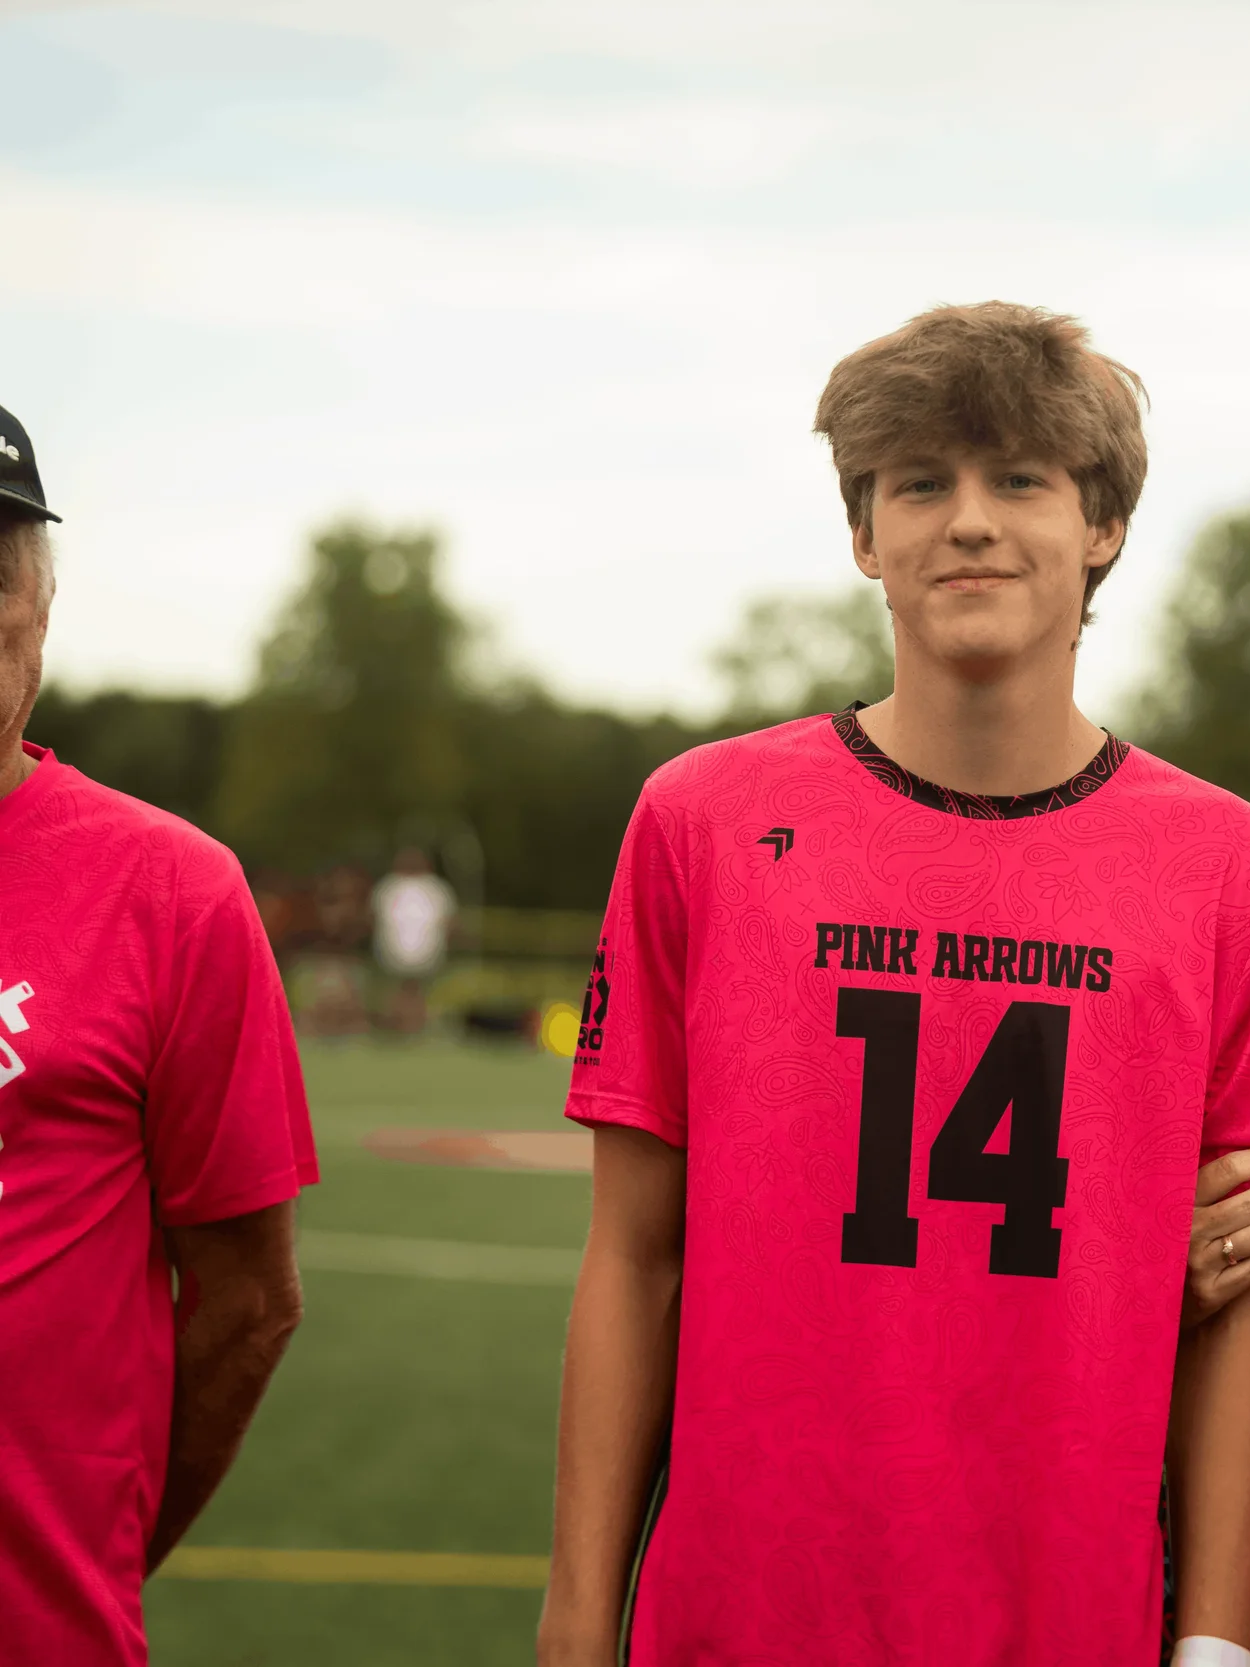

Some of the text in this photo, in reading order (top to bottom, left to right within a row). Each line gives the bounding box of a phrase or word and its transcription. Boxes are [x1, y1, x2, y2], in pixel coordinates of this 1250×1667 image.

[814, 922, 1113, 993] PINK ARROWS
[836, 987, 1071, 1279] 14
